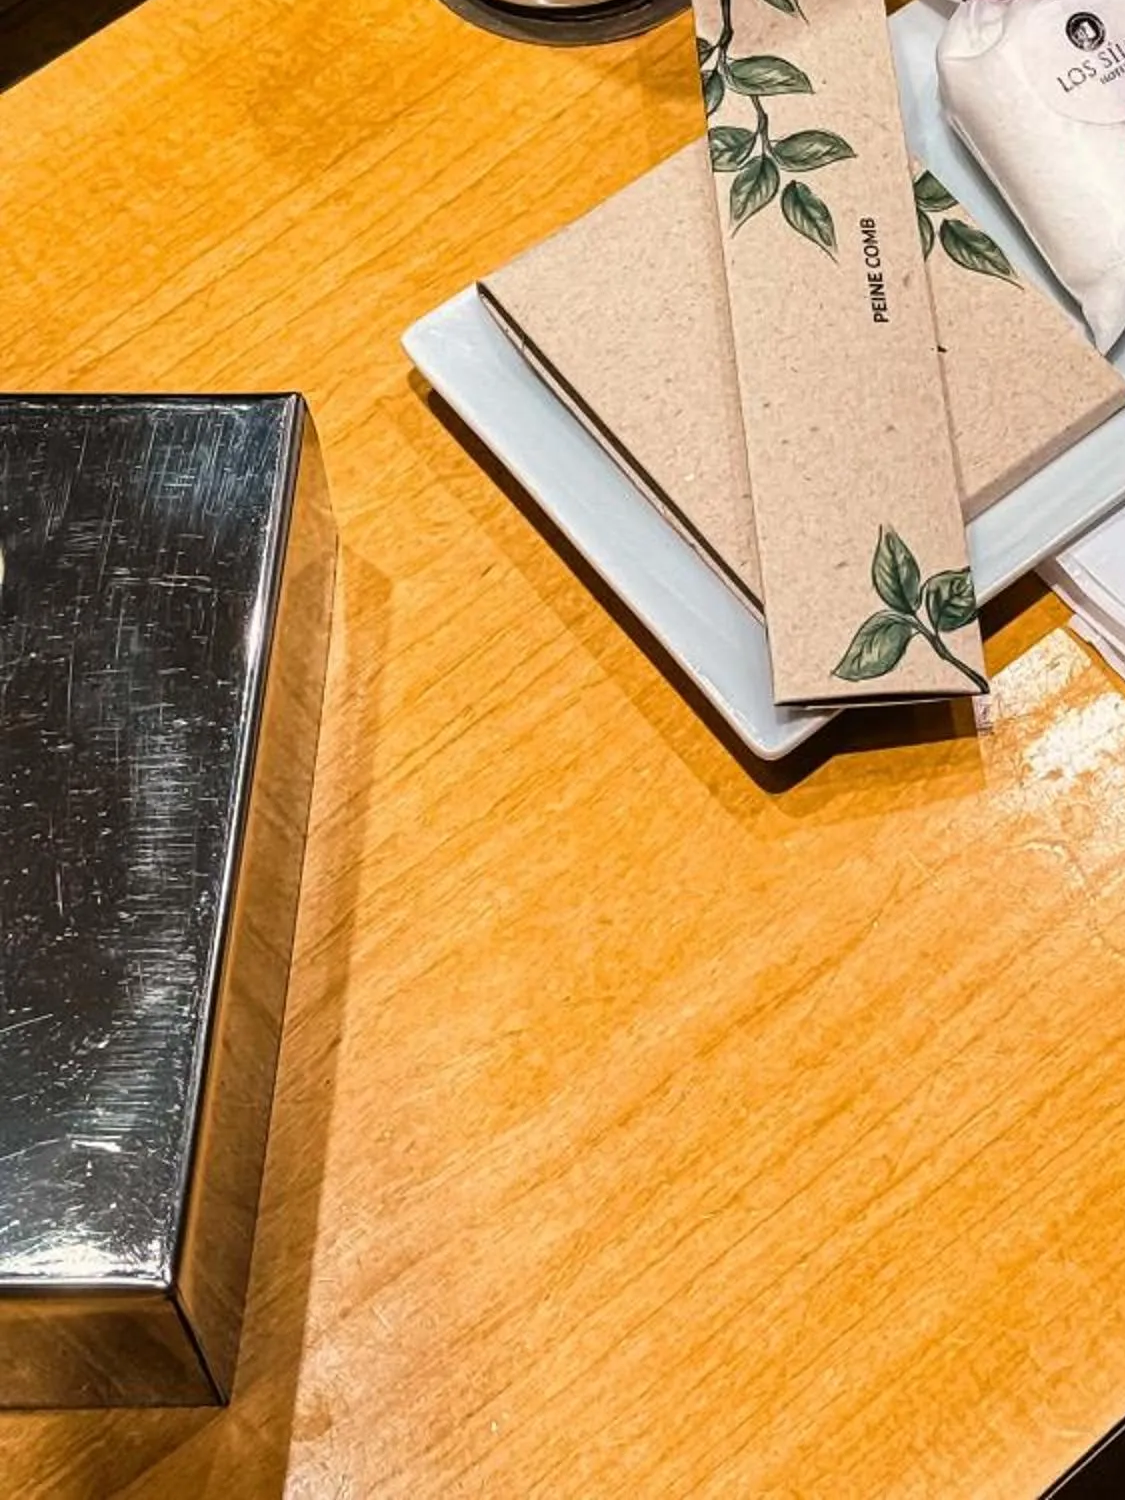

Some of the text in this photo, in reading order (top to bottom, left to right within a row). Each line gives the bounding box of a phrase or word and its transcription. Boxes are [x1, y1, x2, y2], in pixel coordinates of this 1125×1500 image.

[1056, 59, 1098, 93] LOS
[859, 217, 890, 323] PEINE COMB
